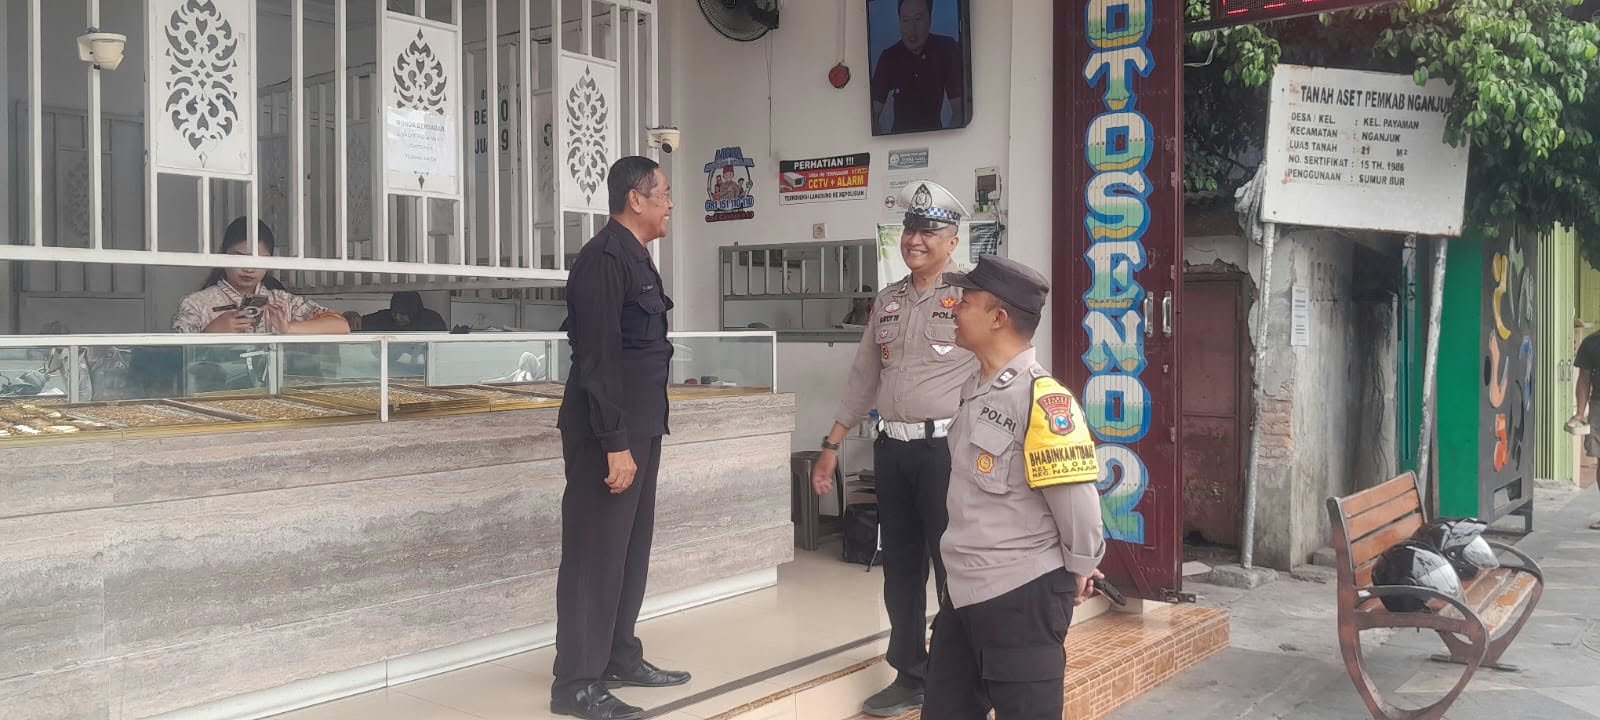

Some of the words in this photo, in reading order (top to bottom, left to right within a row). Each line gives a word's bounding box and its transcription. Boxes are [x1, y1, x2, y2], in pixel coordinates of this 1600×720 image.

[1300, 85, 1334, 105] TANAH
[1336, 88, 1363, 107] ASET
[1365, 90, 1404, 110] PEMKAB
[1291, 112, 1312, 123] DESA
[1318, 114, 1336, 125] KEL.
[1363, 117, 1381, 127] KEL.
[1383, 119, 1420, 129] PAYAMAN
[1290, 126, 1338, 138] KECAMATAN
[1361, 131, 1401, 143] NGANJUK
[1289, 141, 1309, 150] LUAS
[1311, 142, 1338, 153] TANAH
[793, 157, 844, 170] PERHATIAN
[1288, 154, 1302, 163] NO.
[1303, 155, 1349, 168] SERTIFIKAT
[1360, 160, 1370, 169] 15
[1372, 161, 1384, 170] TH.
[1387, 162, 1405, 172] 1986
[808, 178, 828, 189] CCTV
[837, 174, 864, 187] ALARM
[1287, 168, 1341, 181] PENGGUNAAN
[1359, 174, 1387, 185] SUMUR
[980, 406, 1017, 433] POLRI
